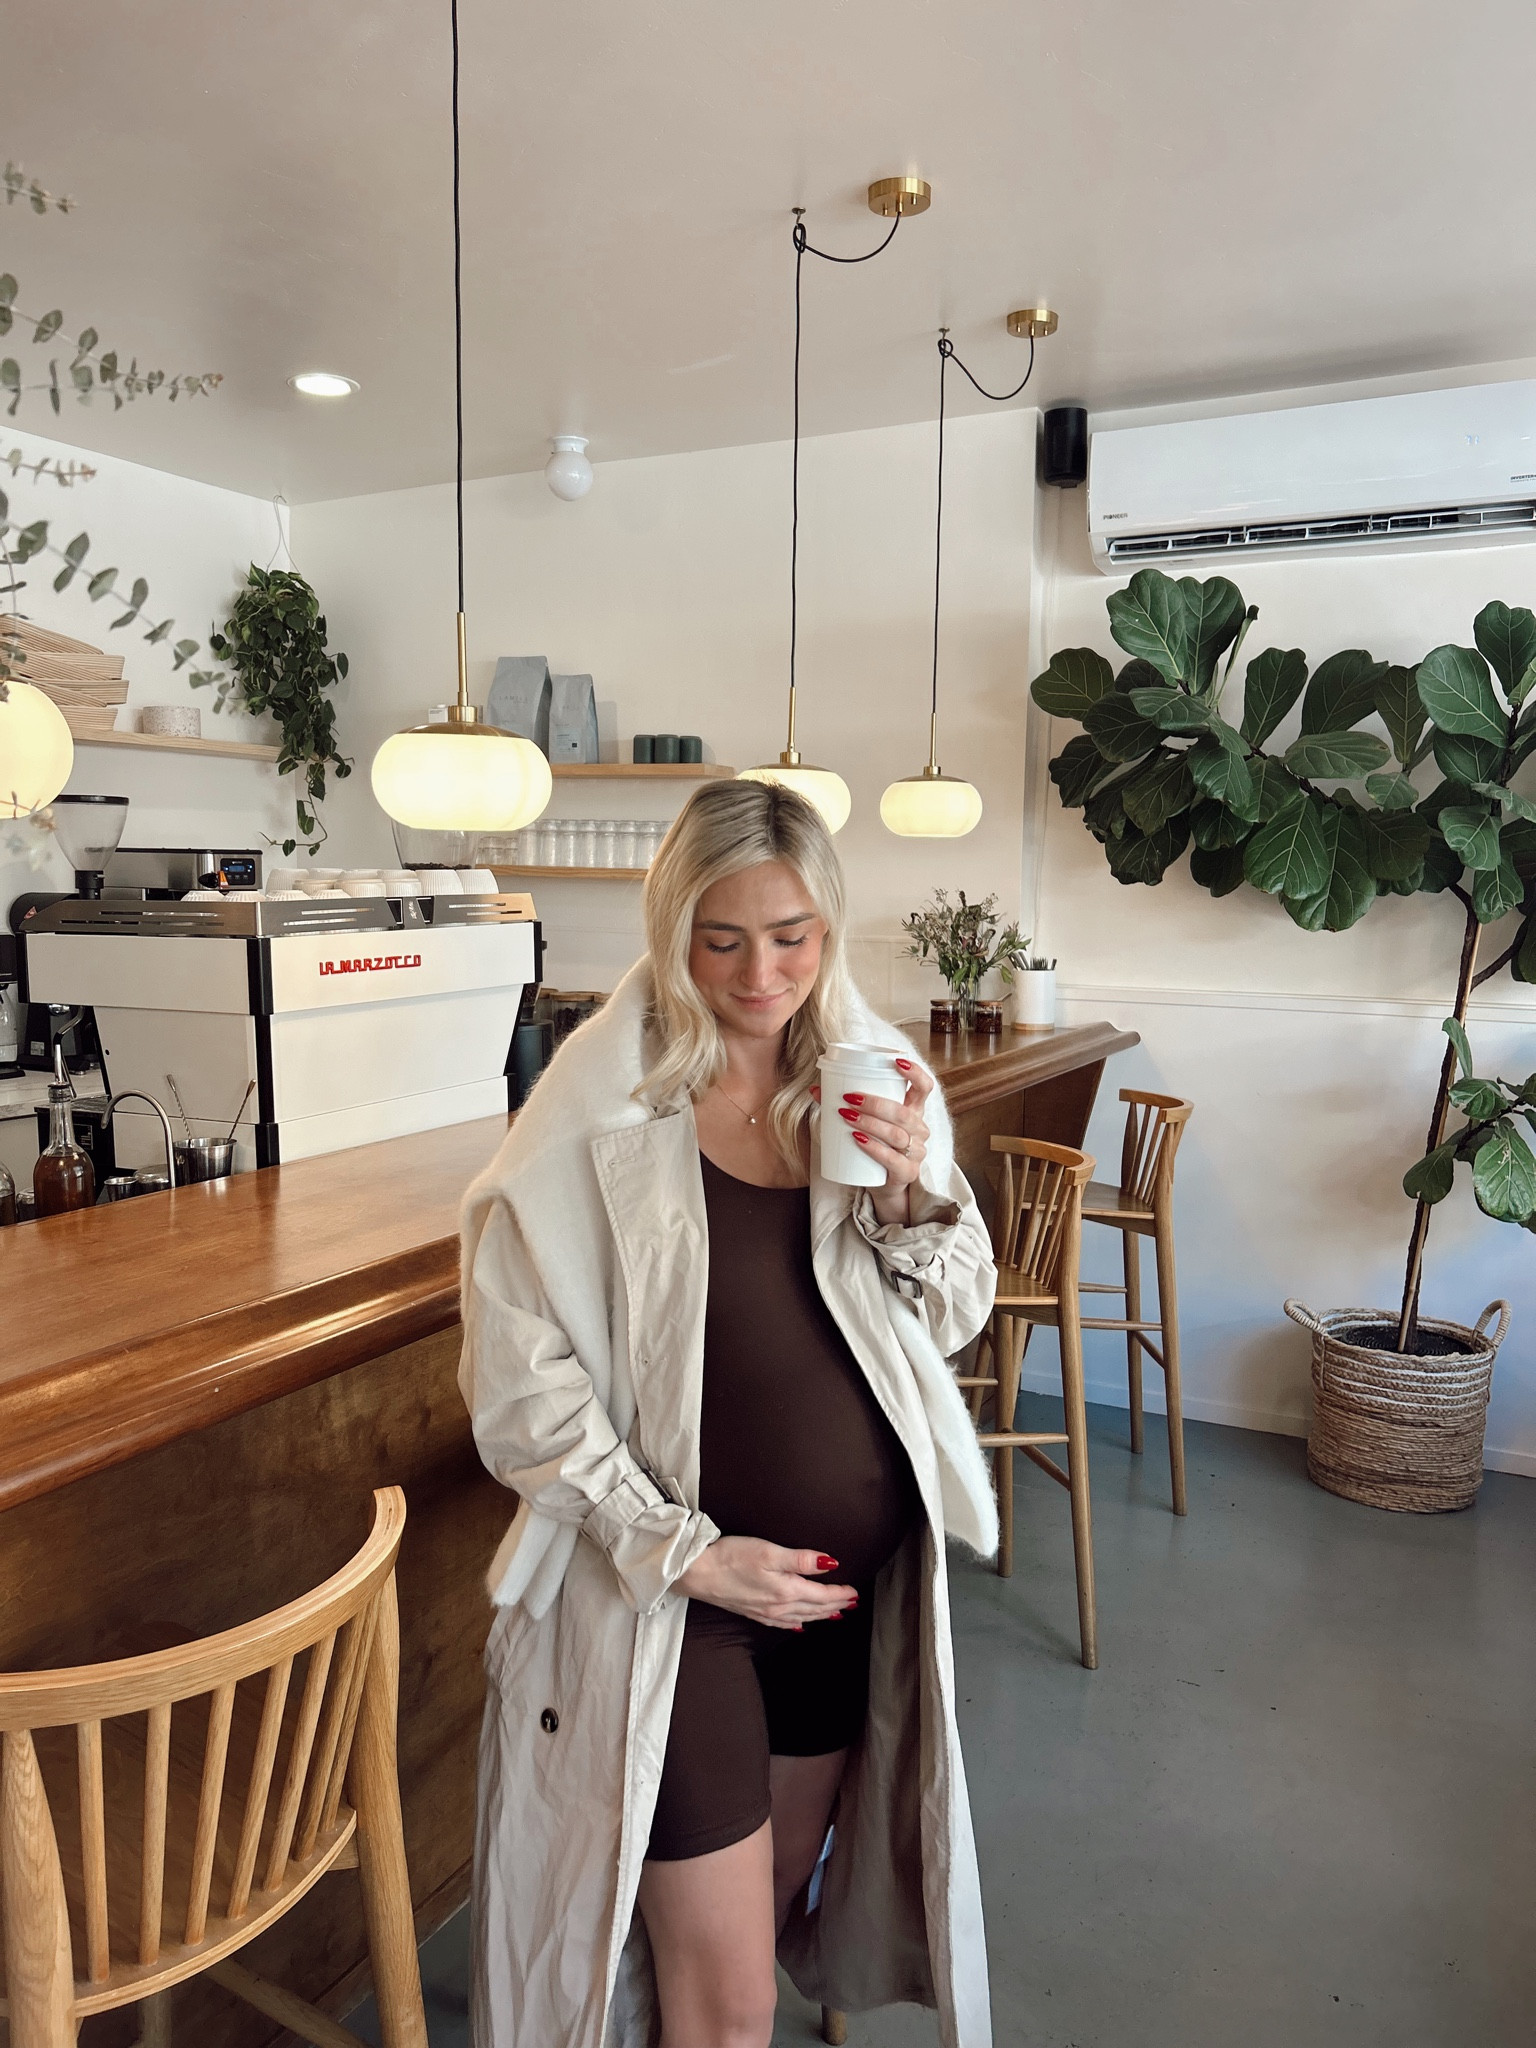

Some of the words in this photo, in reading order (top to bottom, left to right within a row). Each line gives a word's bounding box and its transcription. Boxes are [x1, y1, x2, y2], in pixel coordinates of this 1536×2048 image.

[1103, 512, 1129, 520] PIONEER
[319, 961, 335, 976] LA
[340, 954, 422, 973] MARZOCCO
